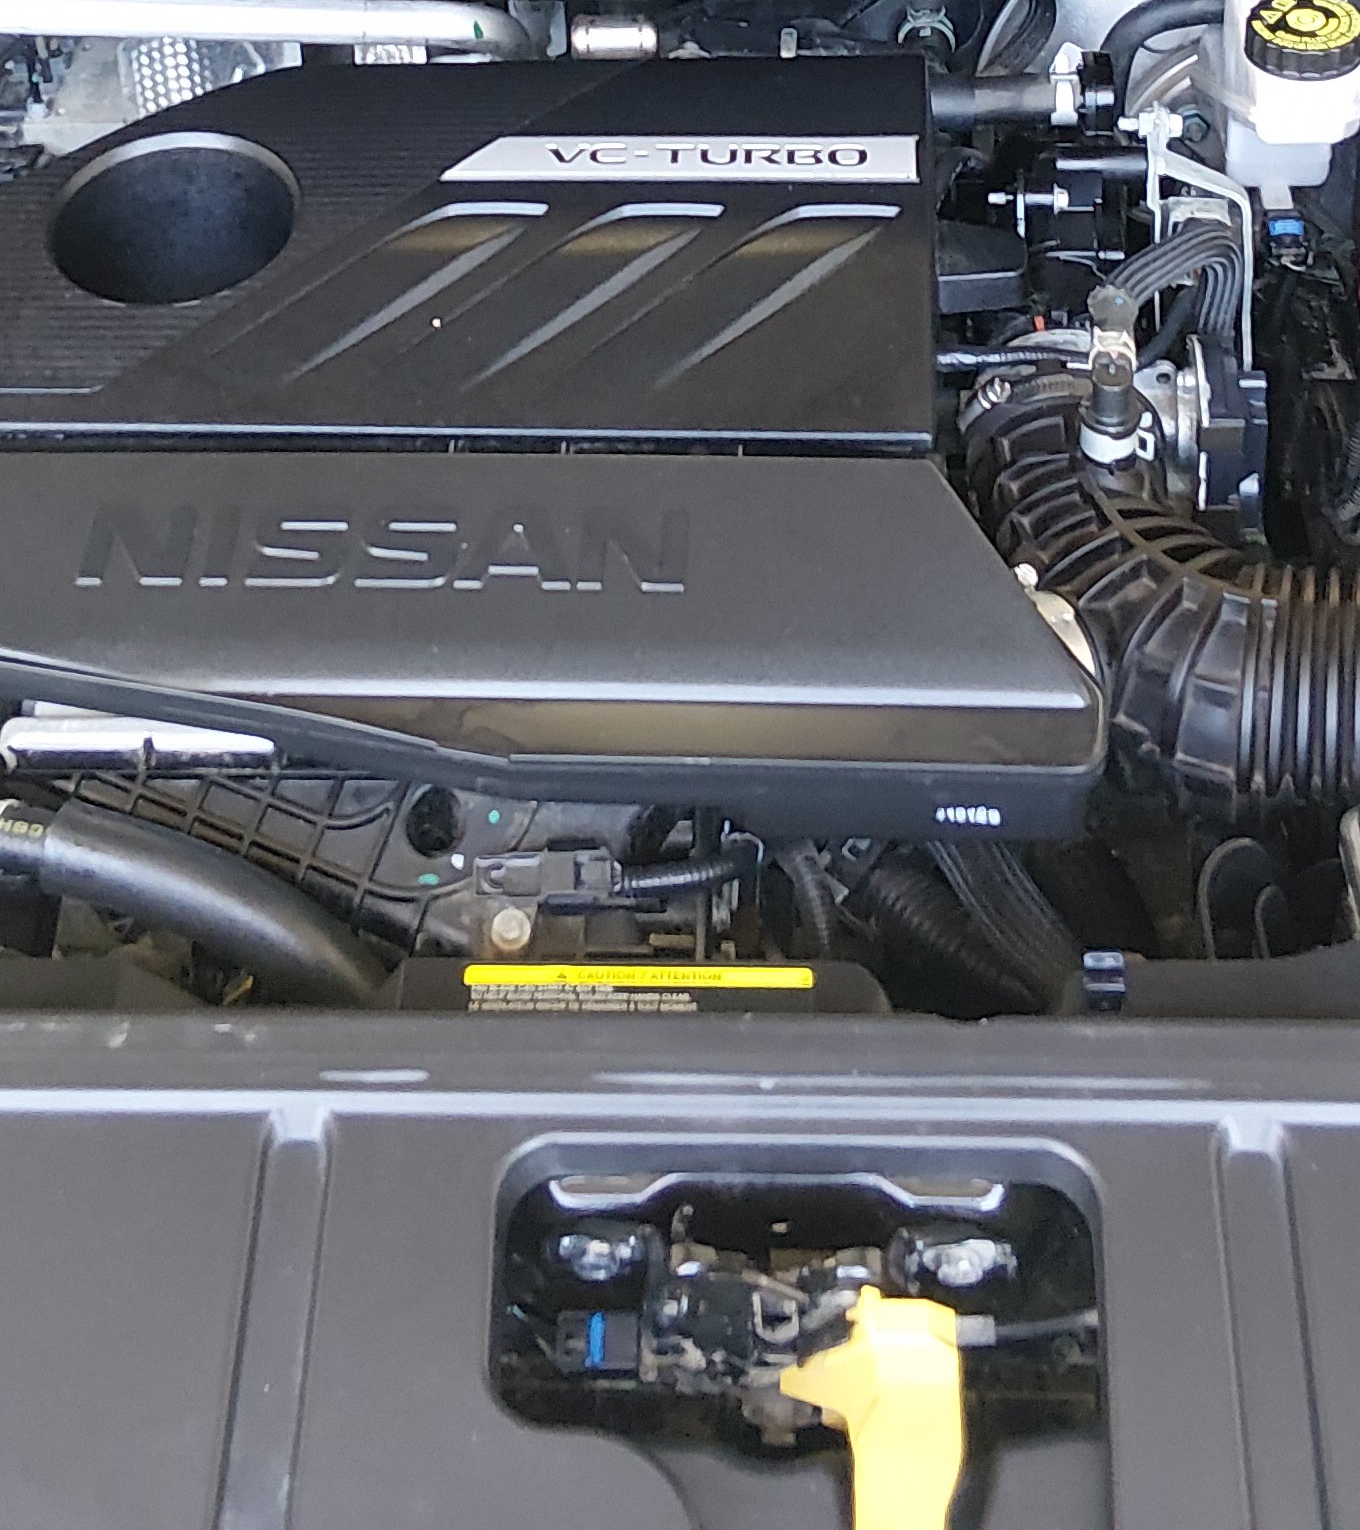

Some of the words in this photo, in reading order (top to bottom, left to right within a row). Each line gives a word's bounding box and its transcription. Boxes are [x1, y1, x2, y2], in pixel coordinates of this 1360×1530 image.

[545, 142, 869, 167] VC-TURBO
[74, 504, 689, 592] NISSAN
[578, 970, 635, 981] CAUTION
[650, 971, 722, 982] ATTENTION
